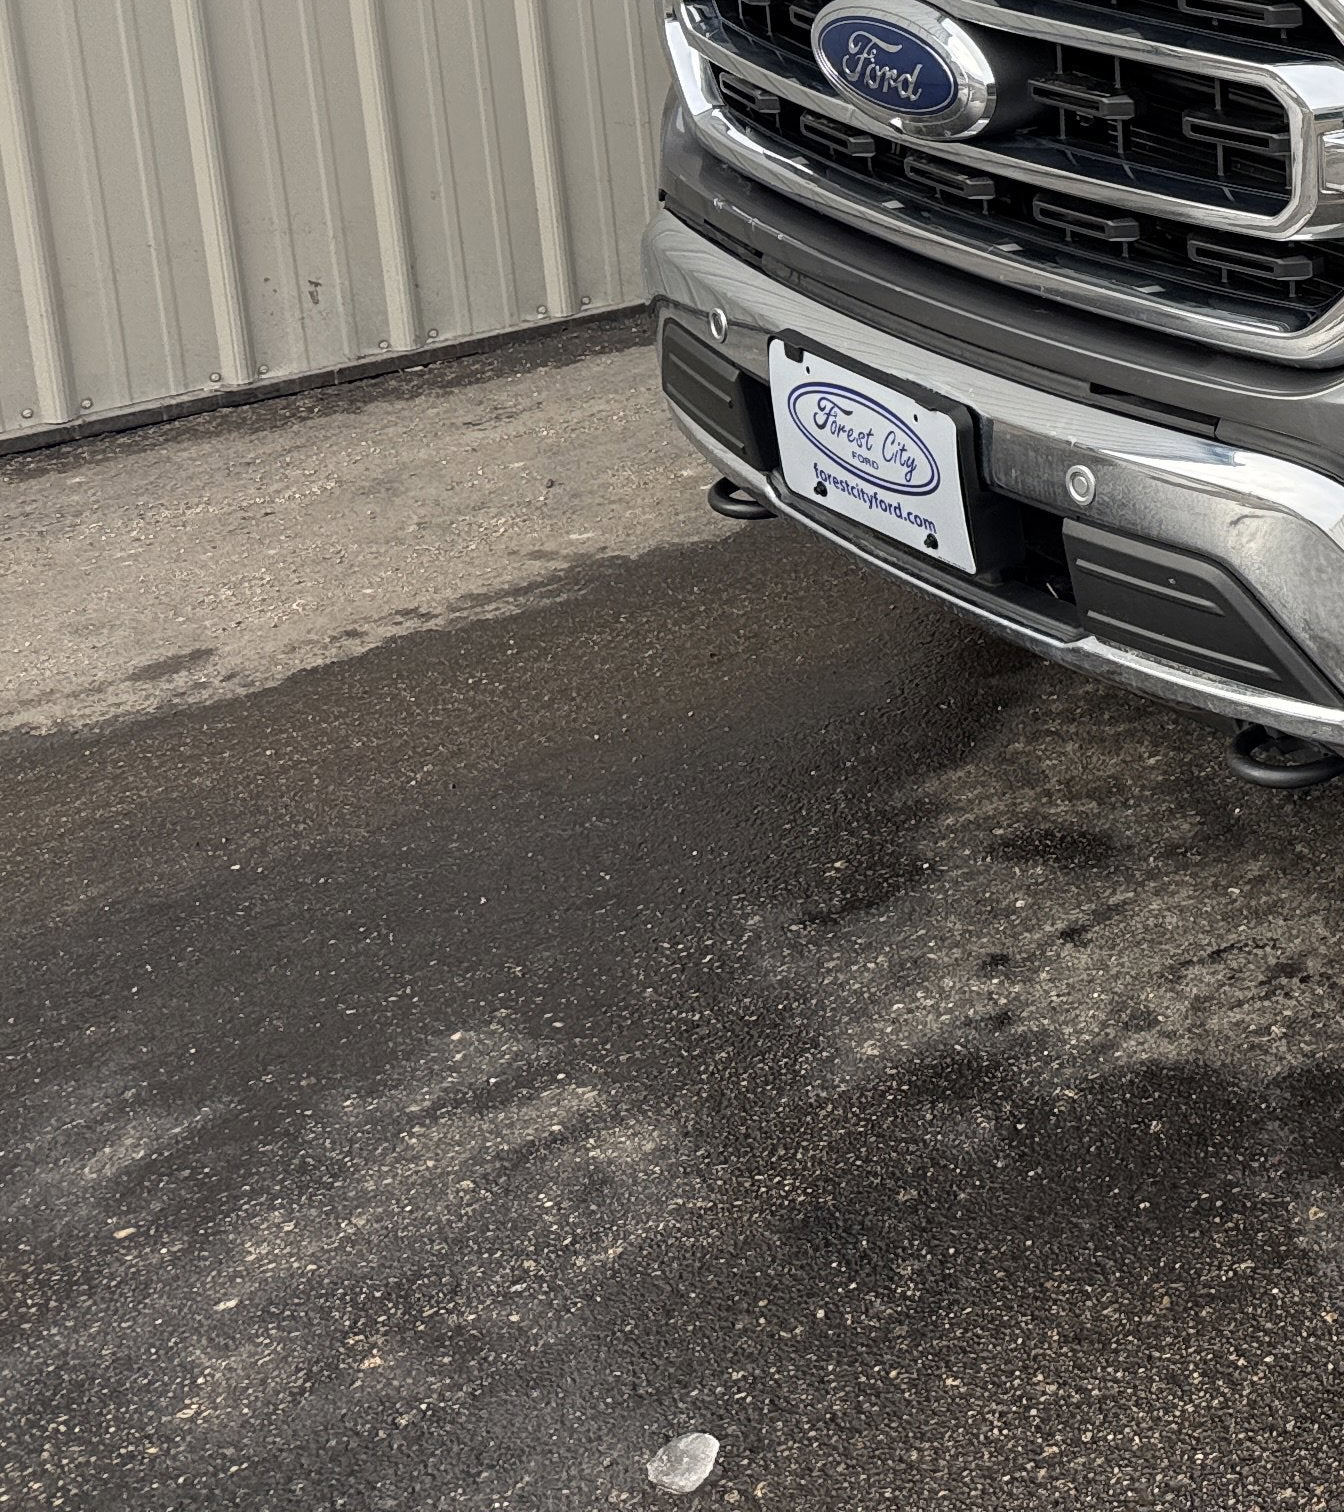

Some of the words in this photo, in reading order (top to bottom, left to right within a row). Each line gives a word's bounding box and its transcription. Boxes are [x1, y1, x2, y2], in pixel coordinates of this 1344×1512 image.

[842, 30, 923, 102] Ford
[813, 396, 874, 452] Forest
[882, 431, 917, 483] City
[851, 451, 879, 470] FORD
[813, 462, 937, 534] forestcityford.com
